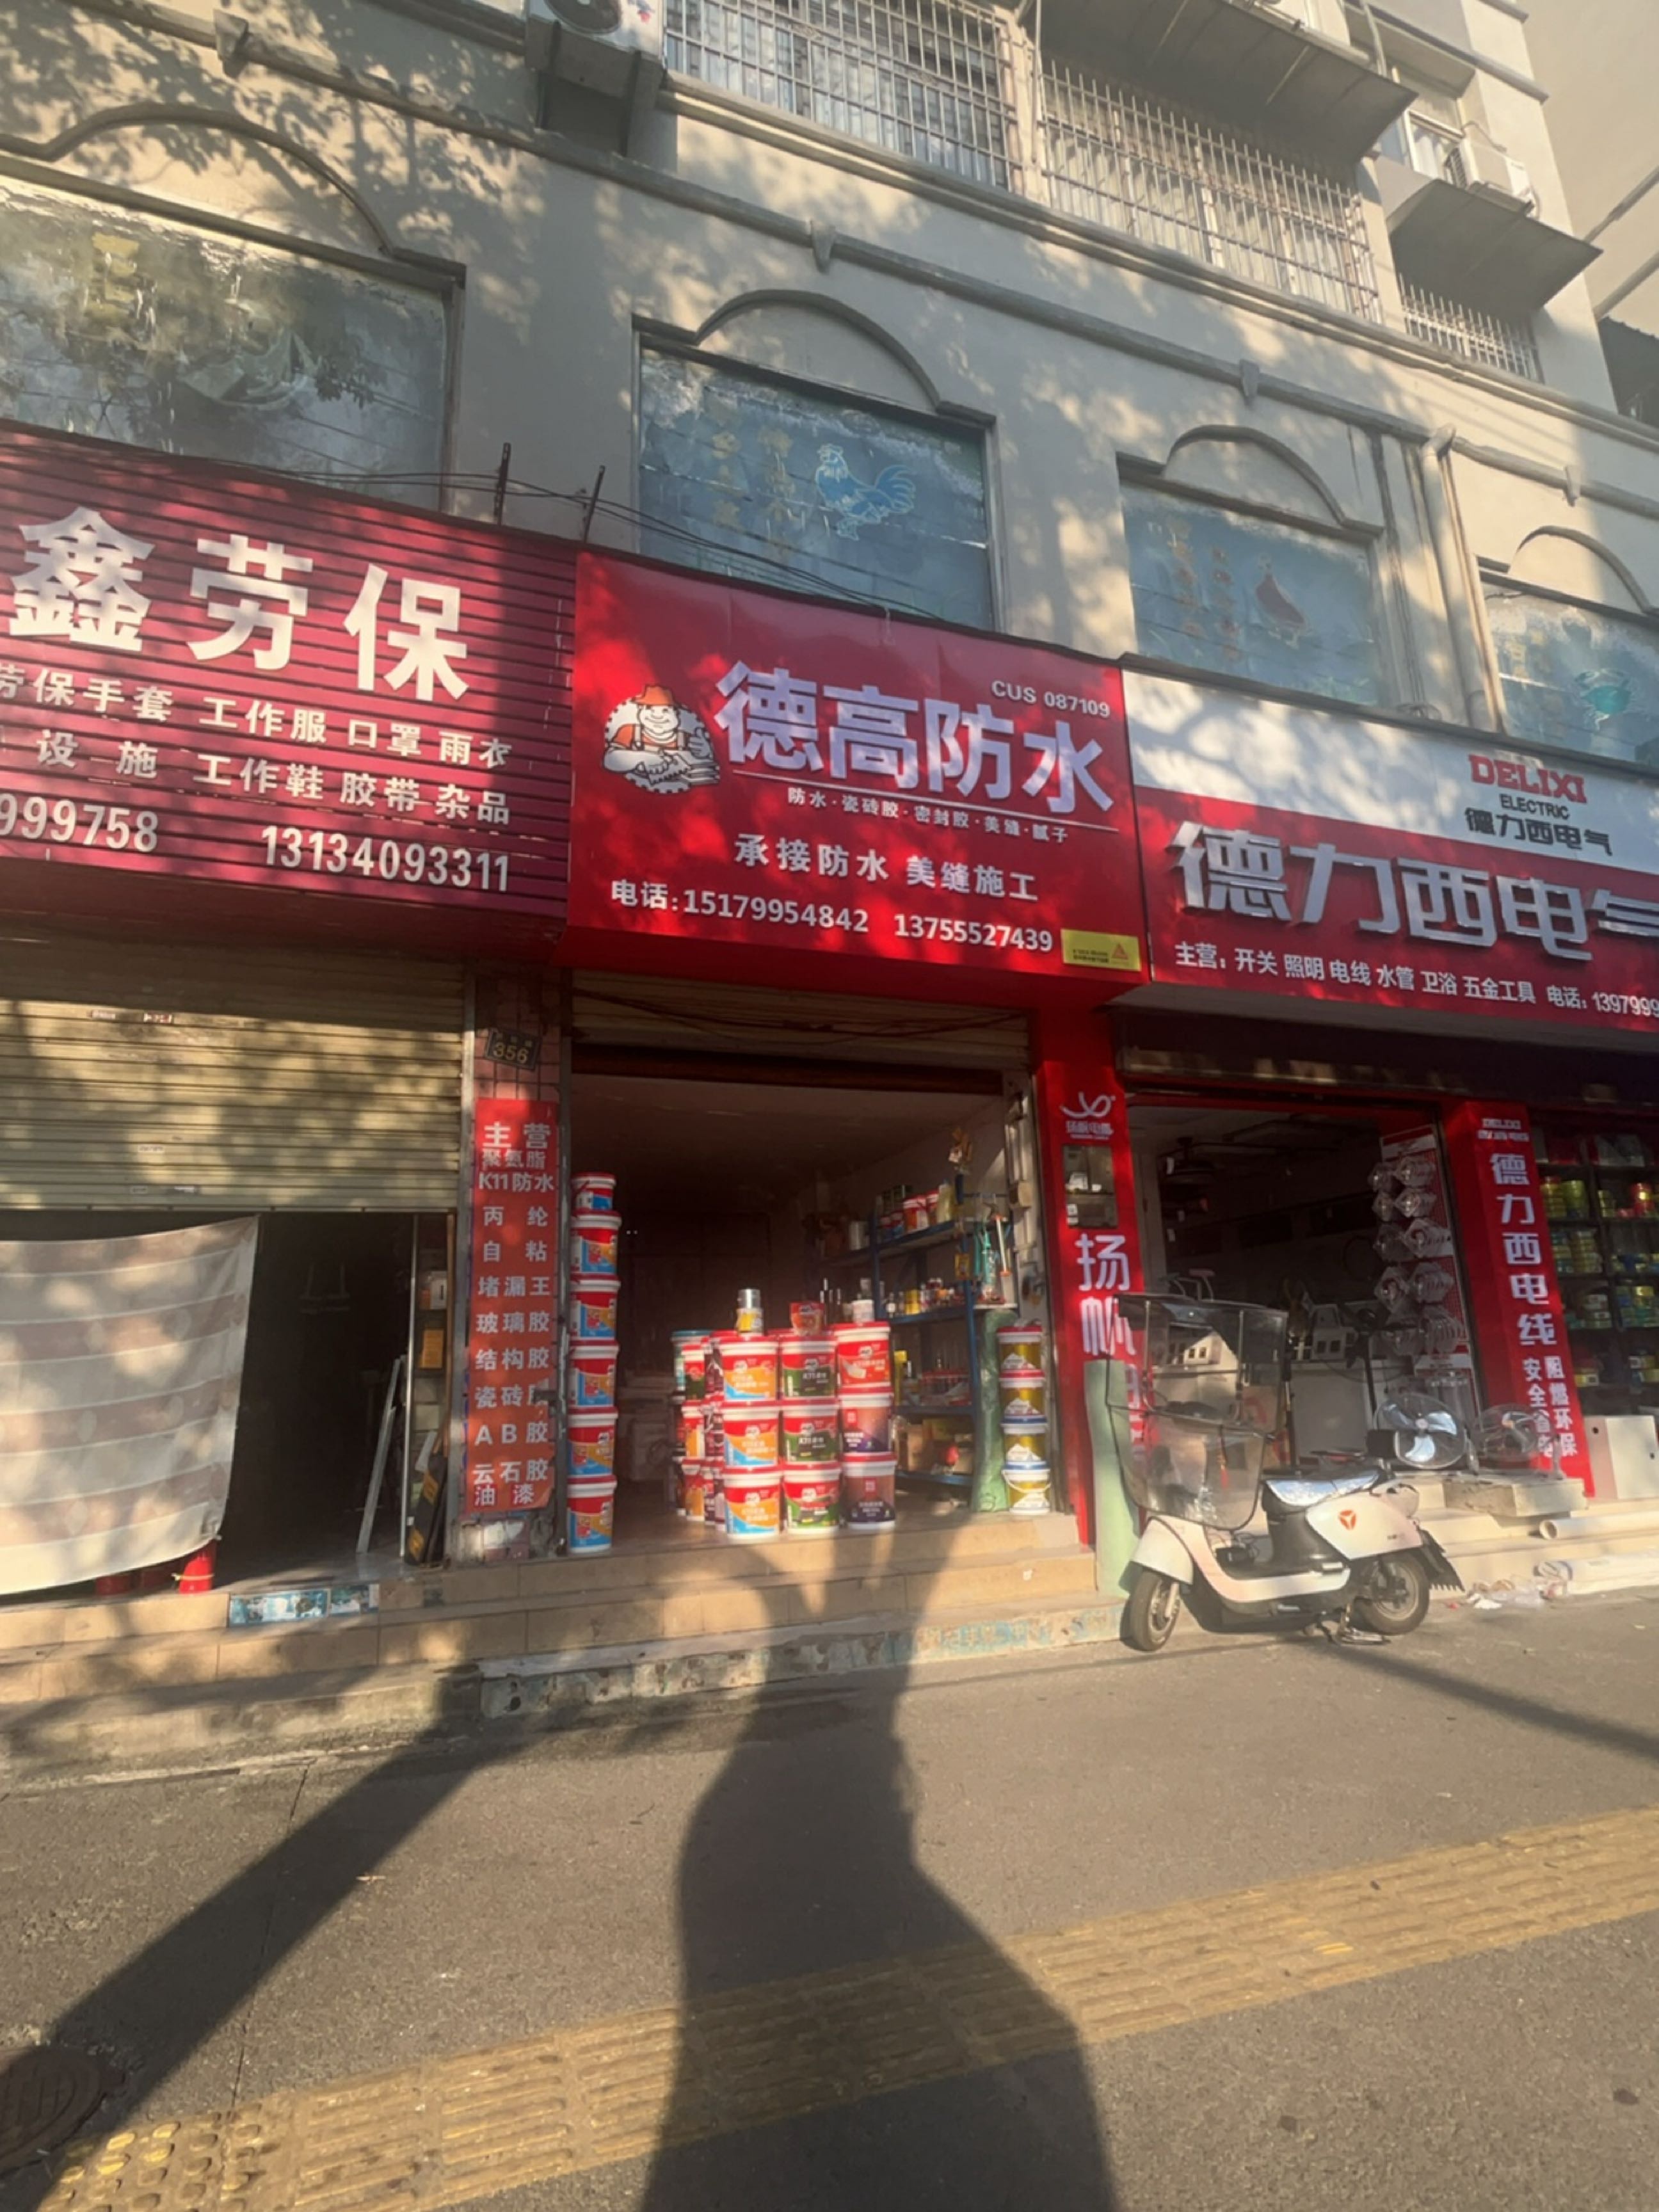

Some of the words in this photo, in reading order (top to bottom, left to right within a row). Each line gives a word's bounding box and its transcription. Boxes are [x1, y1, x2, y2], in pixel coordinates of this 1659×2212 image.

[10, 506, 469, 701] 鑫劳保
[0, 664, 173, 721] 劳保手套
[199, 697, 327, 744] 工作服
[349, 720, 421, 757] 口罩
[437, 730, 513, 769] 雨衣
[991, 680, 1037, 705] CUS
[1043, 691, 1110, 717] 087109
[715, 661, 1114, 815] 德高防水
[193, 755, 325, 801] 工作鞋
[341, 771, 421, 813] 胶带
[435, 784, 510, 825] 杂品
[1469, 754, 1587, 804] DELIXI
[1465, 807, 1612, 855] 德力西电气
[1500, 794, 1570, 820] ELECTRIC
[0, 792, 159, 853] 999758
[261, 826, 510, 893] 13134093311
[734, 833, 890, 881] 承接防水
[906, 856, 1038, 901] 美缝施工
[1167, 821, 1659, 960] 德力西电气
[895, 914, 1053, 952] 13755527439
[1235, 950, 1278, 975] 开关
[1285, 954, 1324, 980] 照明
[1331, 959, 1371, 986] 电线
[1377, 965, 1415, 990] 水管
[1420, 971, 1457, 997] 卫浴
[1464, 977, 1536, 1004] 五金工具
[493, 1041, 529, 1063] 356
[1489, 1153, 1557, 1345] 德力西电线
[478, 1276, 550, 1298] 堵漏王
[476, 1311, 549, 1334] 玻璃胶
[475, 1347, 549, 1371] 结构胶
[473, 1458, 549, 1485] 云石胶
